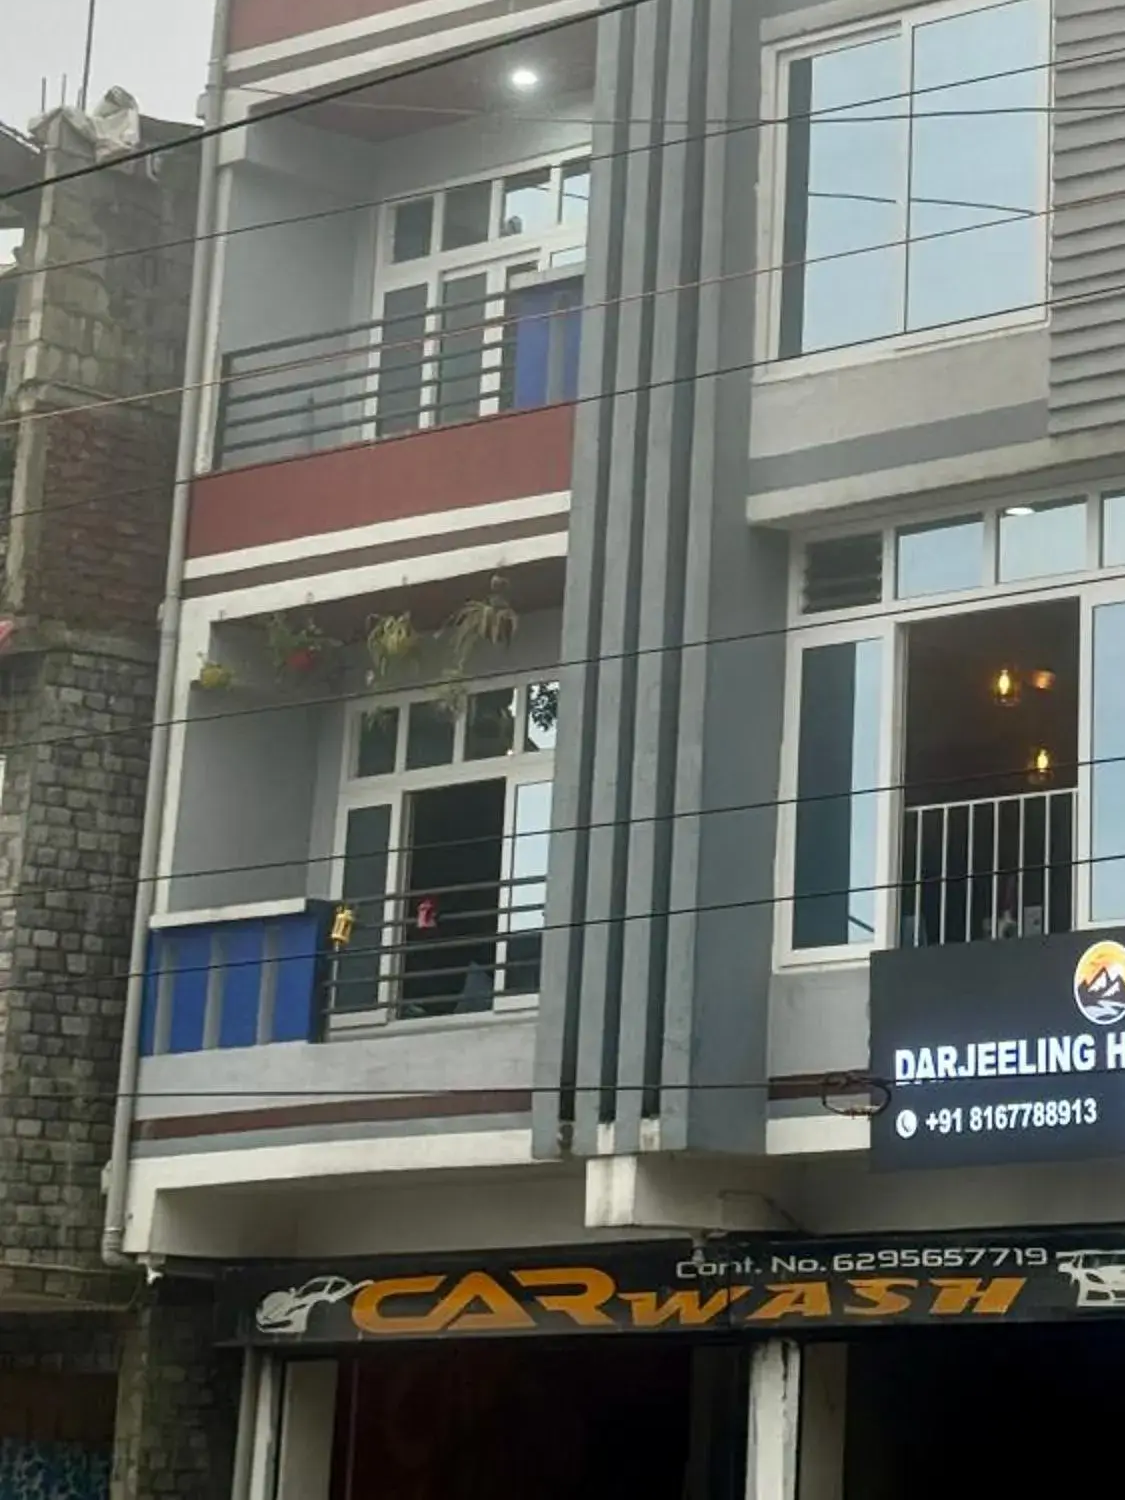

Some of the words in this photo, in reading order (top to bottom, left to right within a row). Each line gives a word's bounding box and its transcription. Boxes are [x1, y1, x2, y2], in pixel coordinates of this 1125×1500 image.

[895, 1034, 1096, 1085] DARJEELING
[925, 1107, 963, 1133] +91
[969, 1098, 1098, 1132] 8167788913
[832, 1248, 1048, 1272] 6295657719
